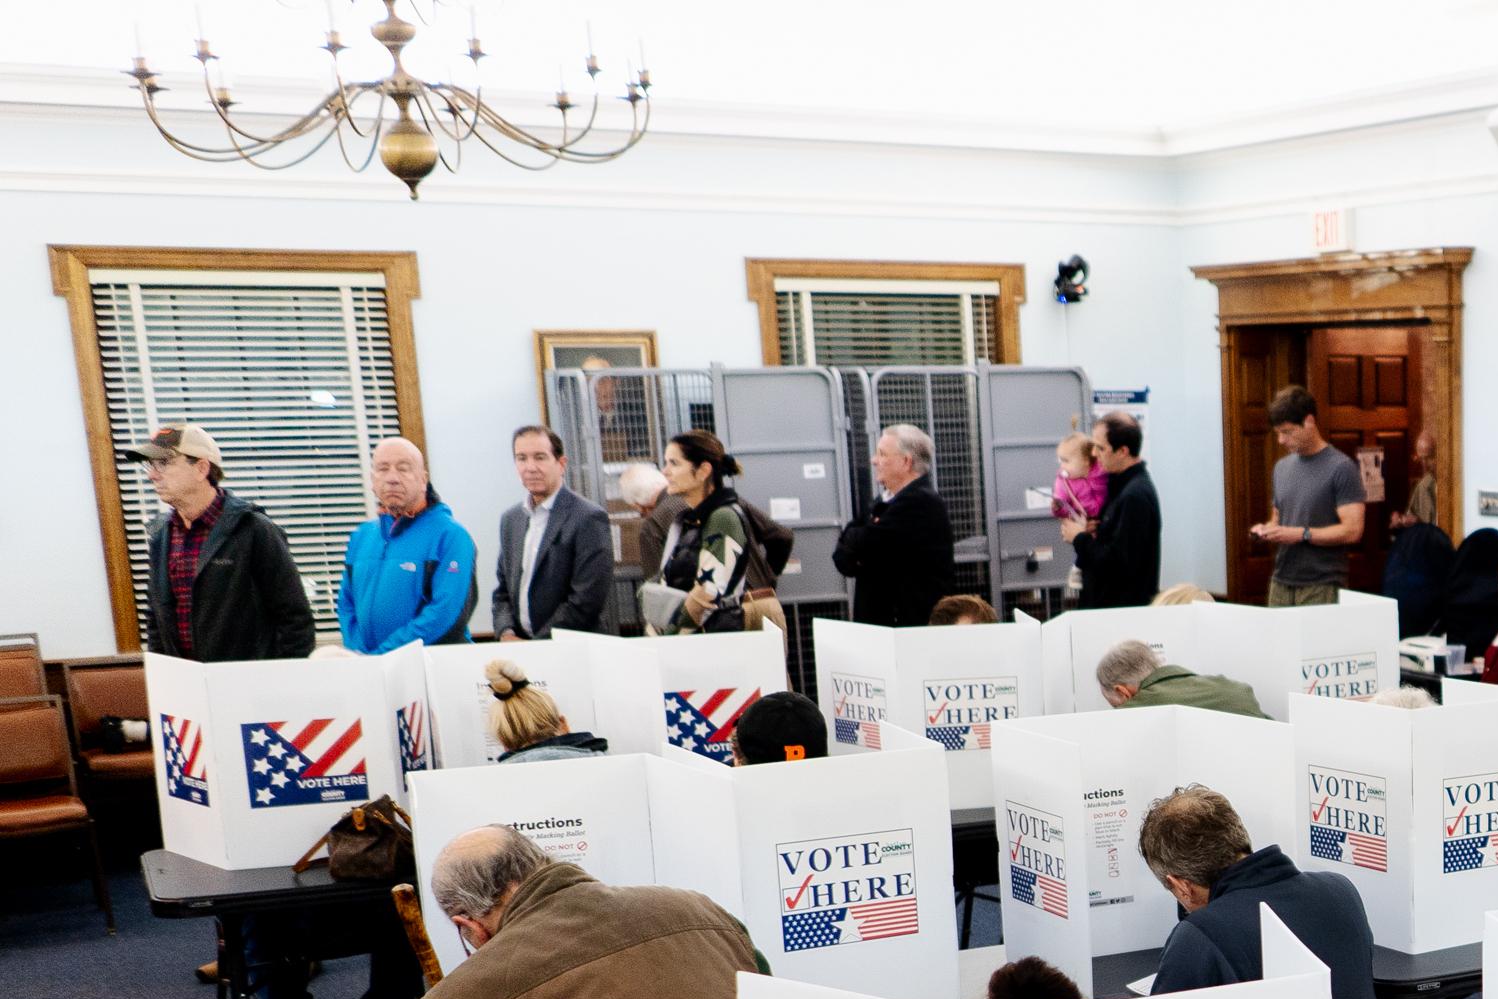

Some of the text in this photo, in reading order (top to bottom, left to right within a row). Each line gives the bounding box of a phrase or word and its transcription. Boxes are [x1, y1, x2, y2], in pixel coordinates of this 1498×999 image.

[1302, 660, 1358, 680] VOTE
[833, 678, 873, 699] VOTE
[926, 683, 996, 702] VOTE
[1315, 680, 1376, 697] HERE
[846, 703, 887, 722] HERE
[946, 706, 1016, 724] HERE
[297, 775, 366, 789] VOTE HERE
[1310, 772, 1368, 803] VOTE
[510, 817, 583, 831] tructions
[1007, 809, 1050, 843] VOTE
[1325, 805, 1386, 837] HERE
[779, 841, 882, 875] VOTE
[881, 843, 911, 853] COUNTY
[1021, 845, 1066, 880] HERE
[810, 873, 914, 908] HERE
